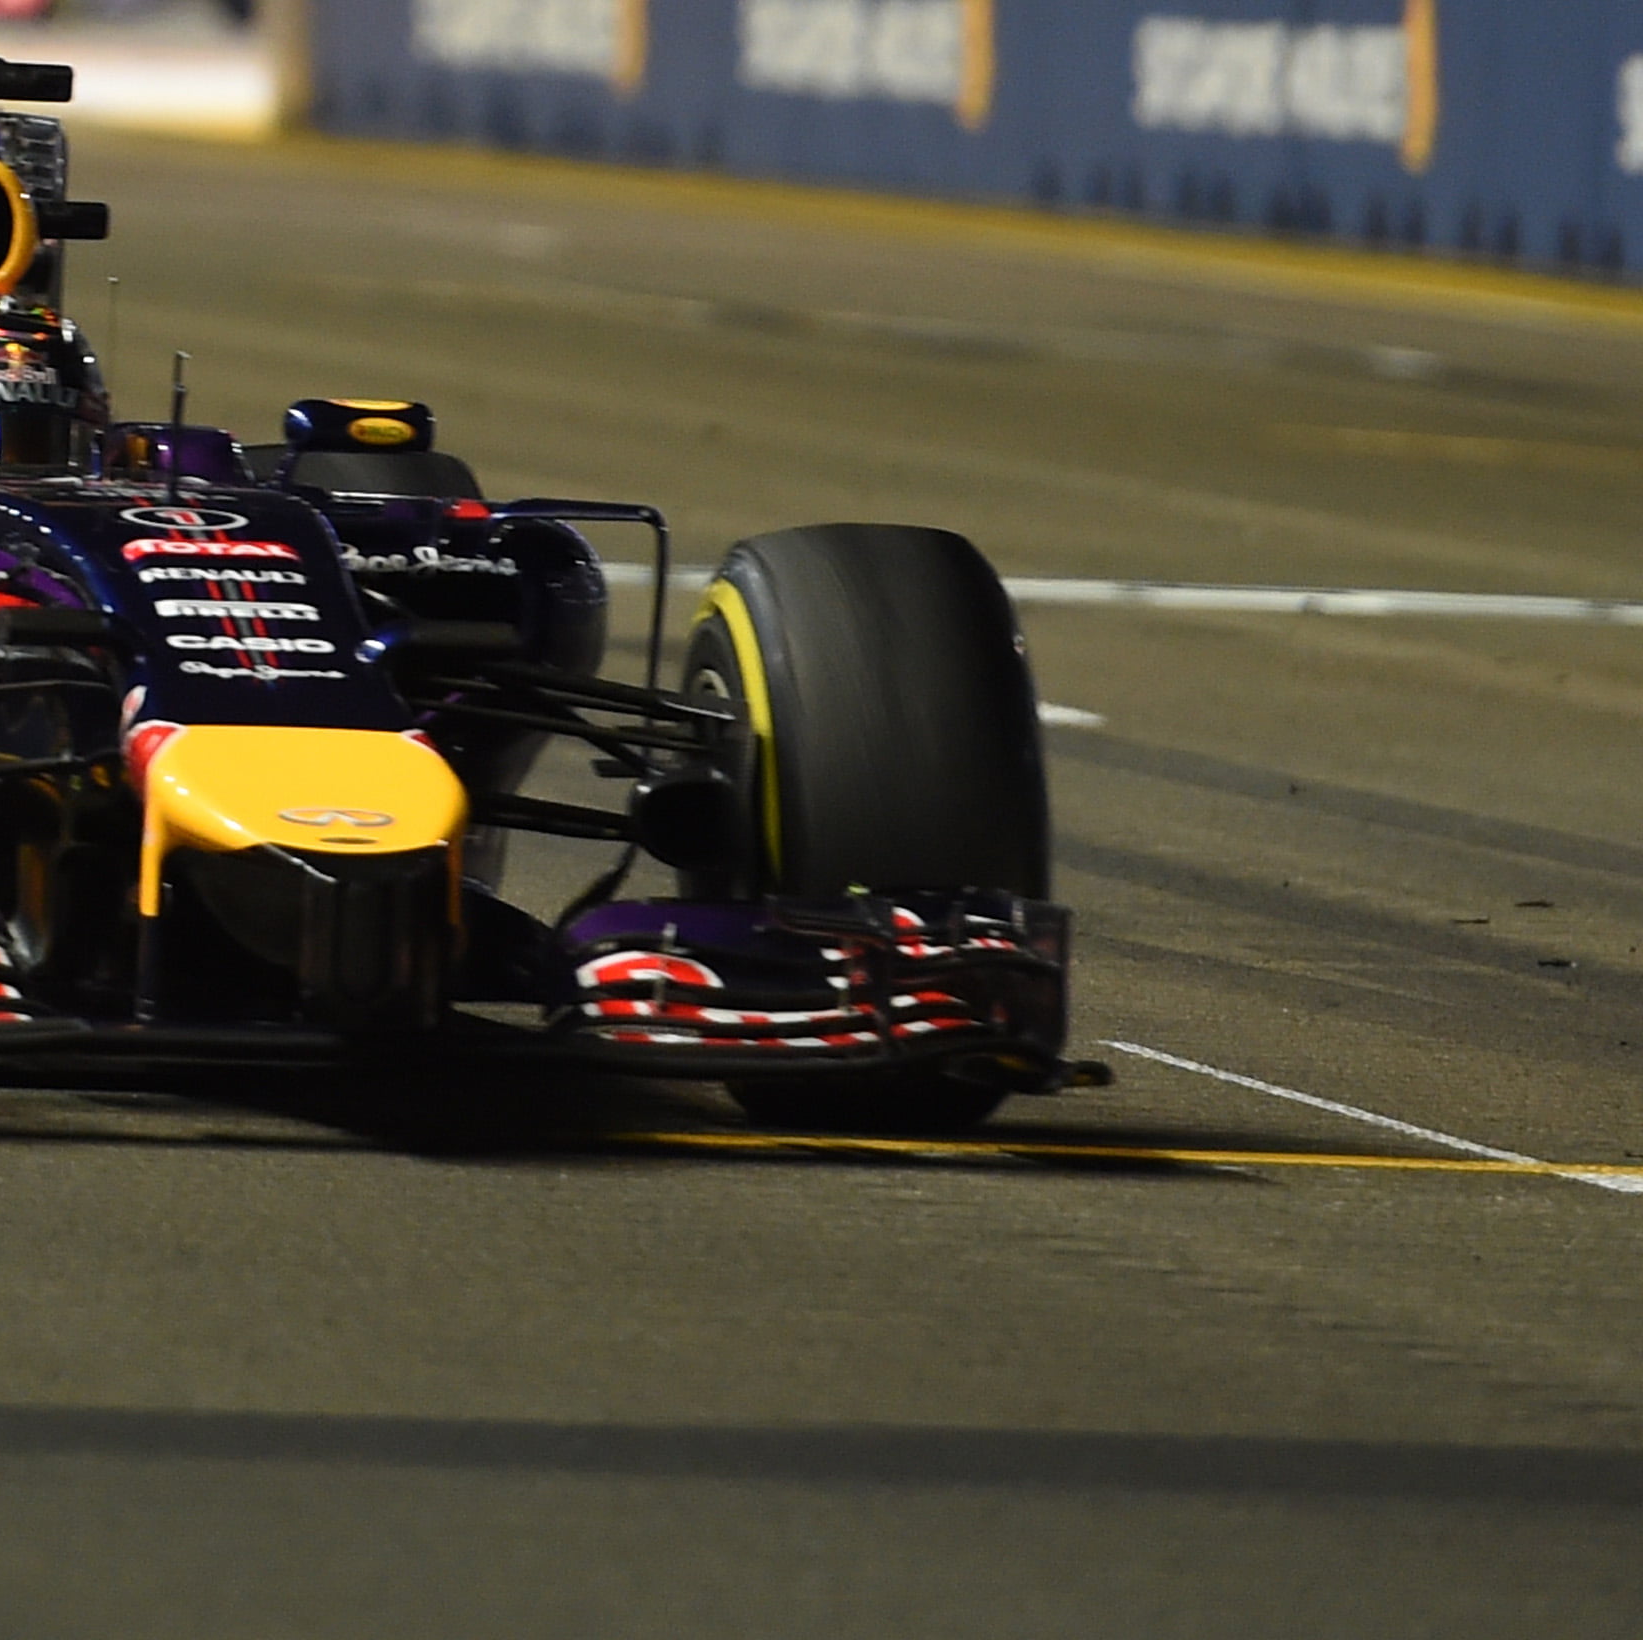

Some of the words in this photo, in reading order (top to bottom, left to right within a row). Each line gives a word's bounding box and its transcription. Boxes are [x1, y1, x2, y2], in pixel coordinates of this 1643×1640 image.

[137, 538, 301, 561] TOTAL
[138, 567, 308, 585] RENAULT
[166, 634, 336, 653] CASIO
